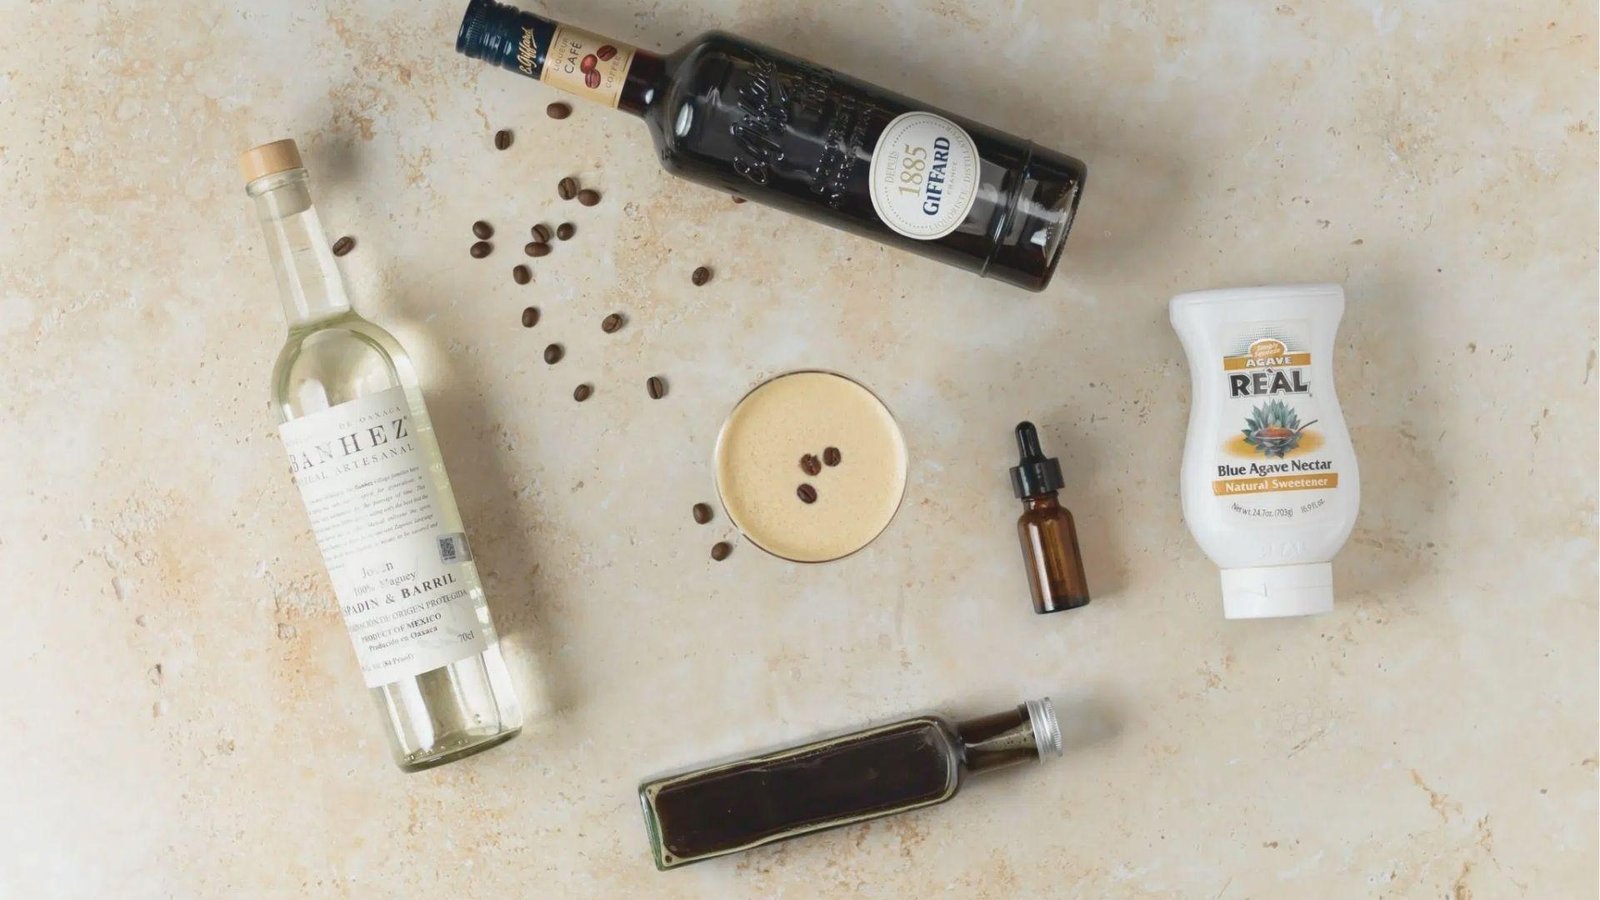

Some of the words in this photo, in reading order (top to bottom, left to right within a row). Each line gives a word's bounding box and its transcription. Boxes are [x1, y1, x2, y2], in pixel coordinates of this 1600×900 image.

[564, 40, 583, 74] CAFÉ
[898, 144, 928, 198] 1885
[922, 136, 951, 216] GIFFARD
[1245, 356, 1292, 368] AGAVE
[359, 406, 402, 423] OAXACA
[289, 417, 409, 472] BANHEZ
[336, 443, 414, 475] ARTESANAL
[1217, 464, 1247, 477] Blue
[1249, 462, 1289, 477] Agave
[1291, 459, 1332, 473] Nectar
[1225, 480, 1269, 493] Natural
[1271, 477, 1328, 490] Sweetener
[1230, 501, 1242, 512] Net
[362, 561, 394, 579] Jon
[385, 593, 396, 605] &
[401, 573, 457, 599] BARRIL
[392, 602, 425, 619] ORIGEN
[425, 589, 468, 609] PROTEGIDA
[393, 625, 406, 633] OF
[406, 612, 442, 629] MEXICO
[410, 626, 438, 640] Oaxaca
[457, 630, 475, 643] 70cl
